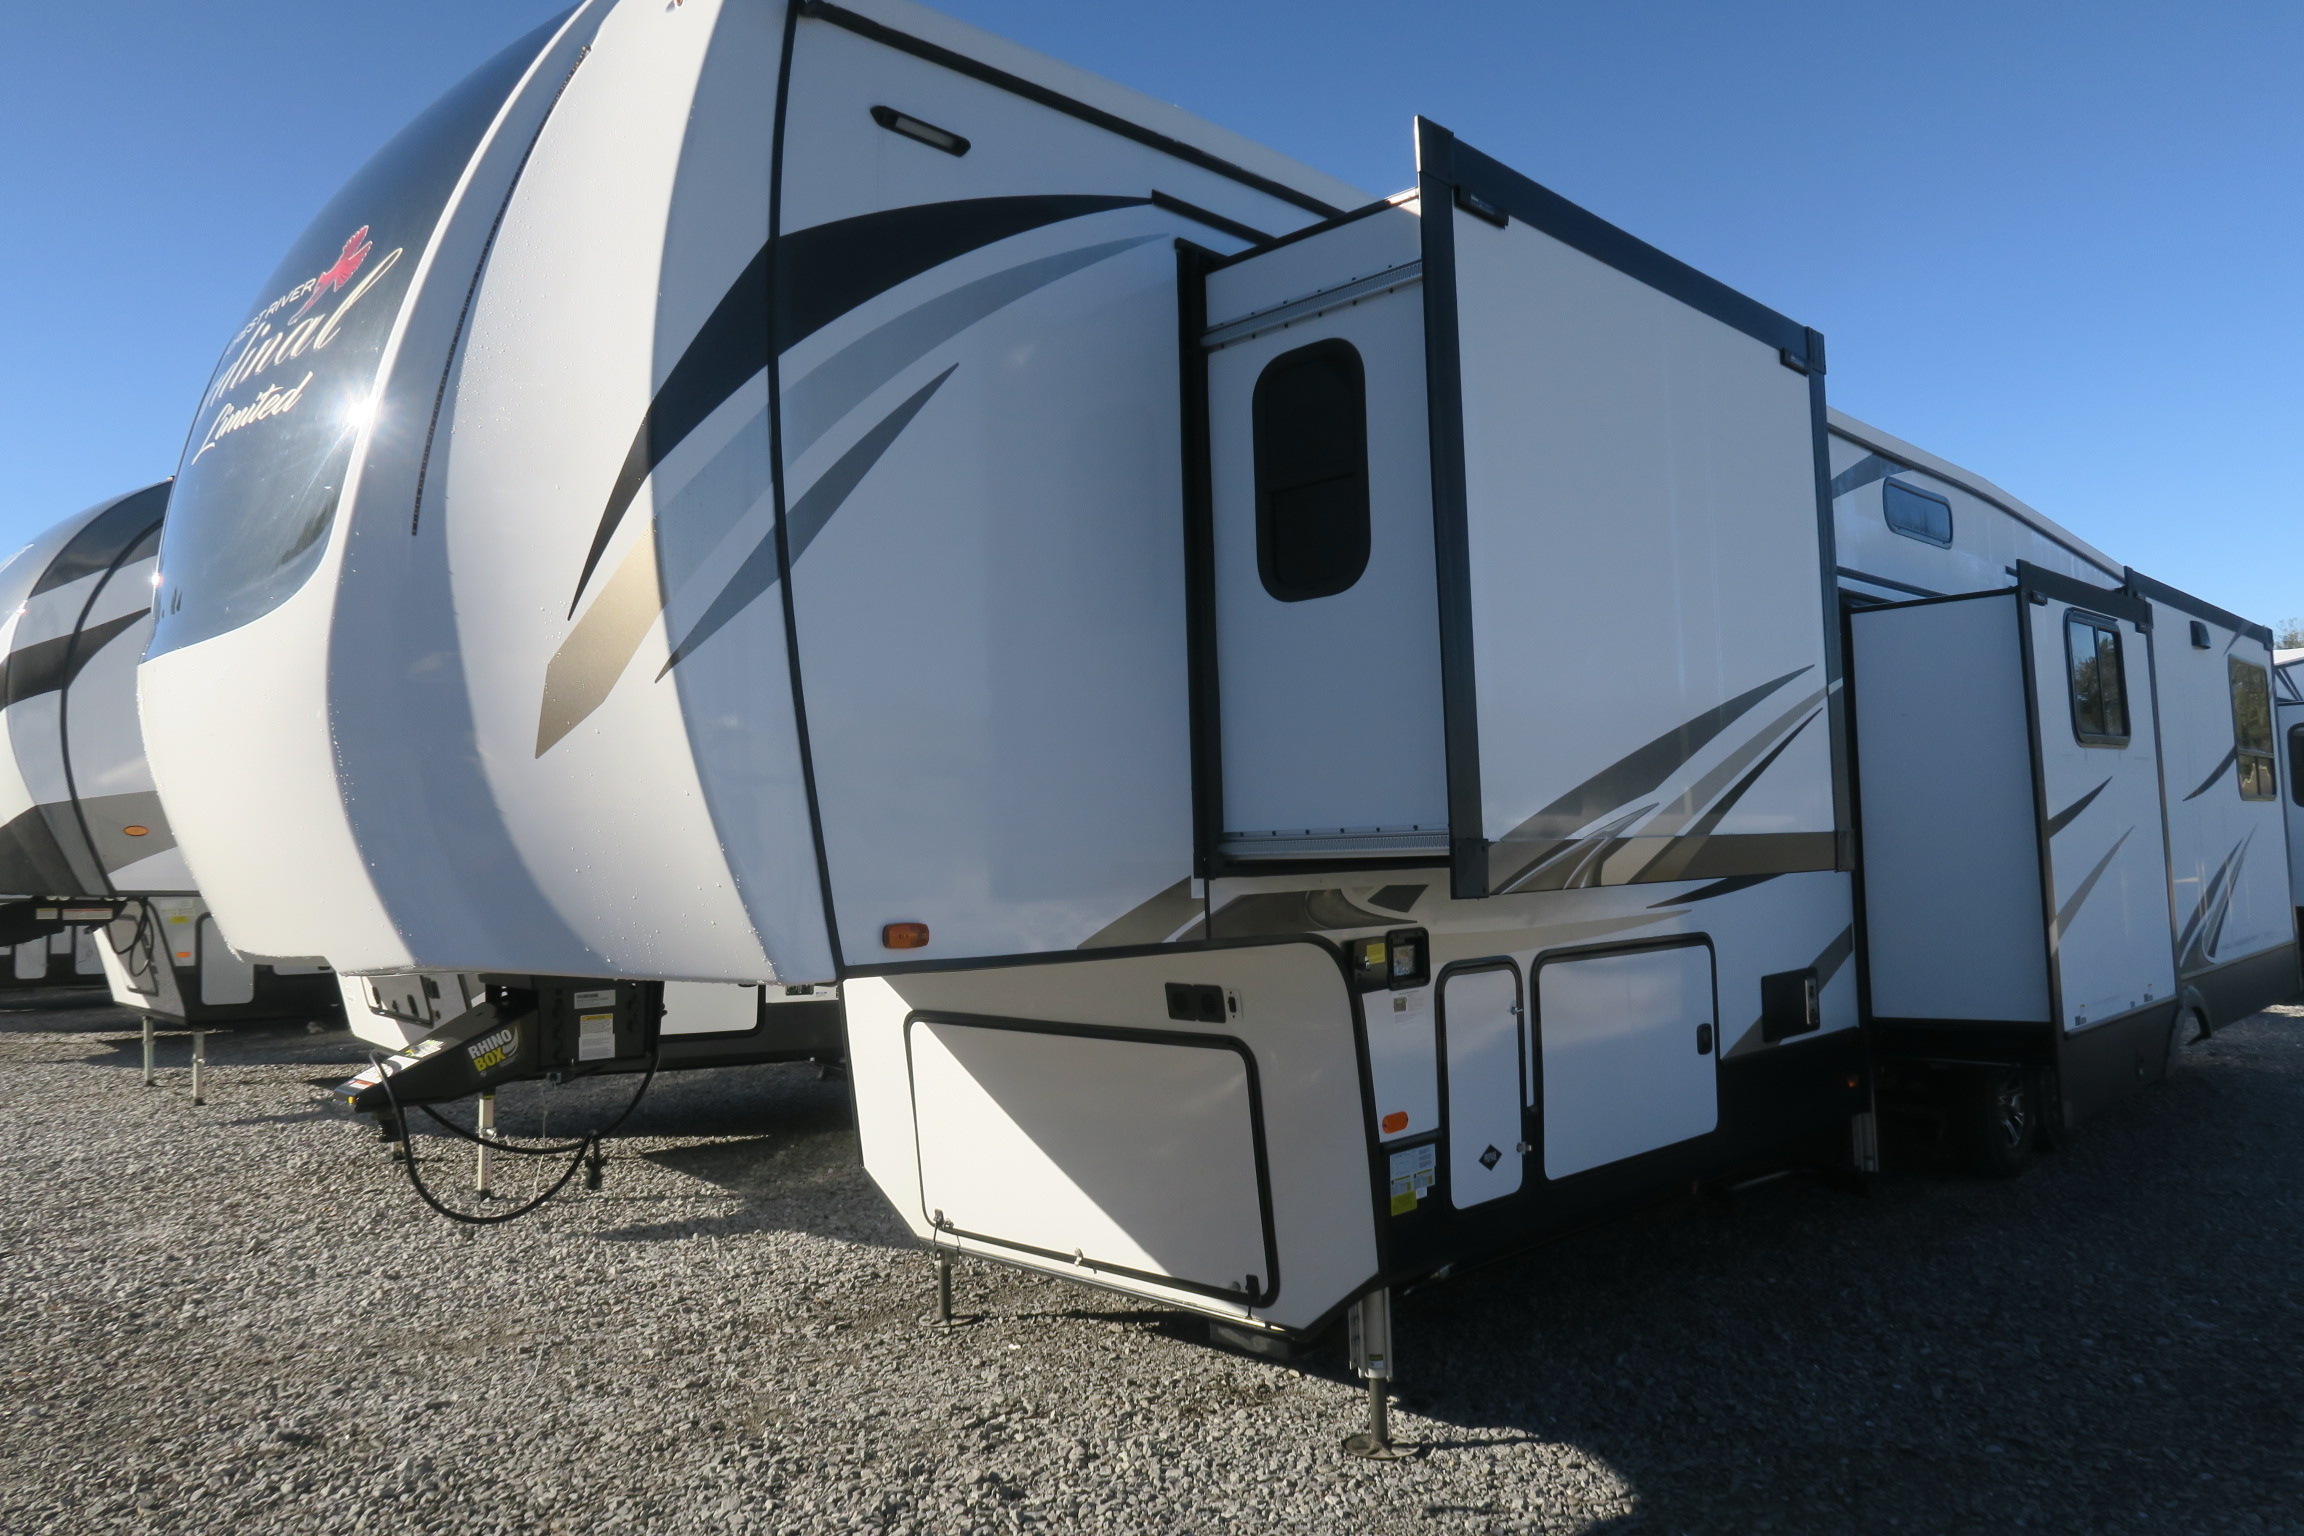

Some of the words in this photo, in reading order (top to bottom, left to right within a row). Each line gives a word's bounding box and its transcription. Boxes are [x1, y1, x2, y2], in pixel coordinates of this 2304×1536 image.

[264, 277, 317, 319] RIVER
[191, 370, 313, 466] Limited
[467, 1029, 513, 1060] RHINO
[473, 1046, 507, 1072] BOX
